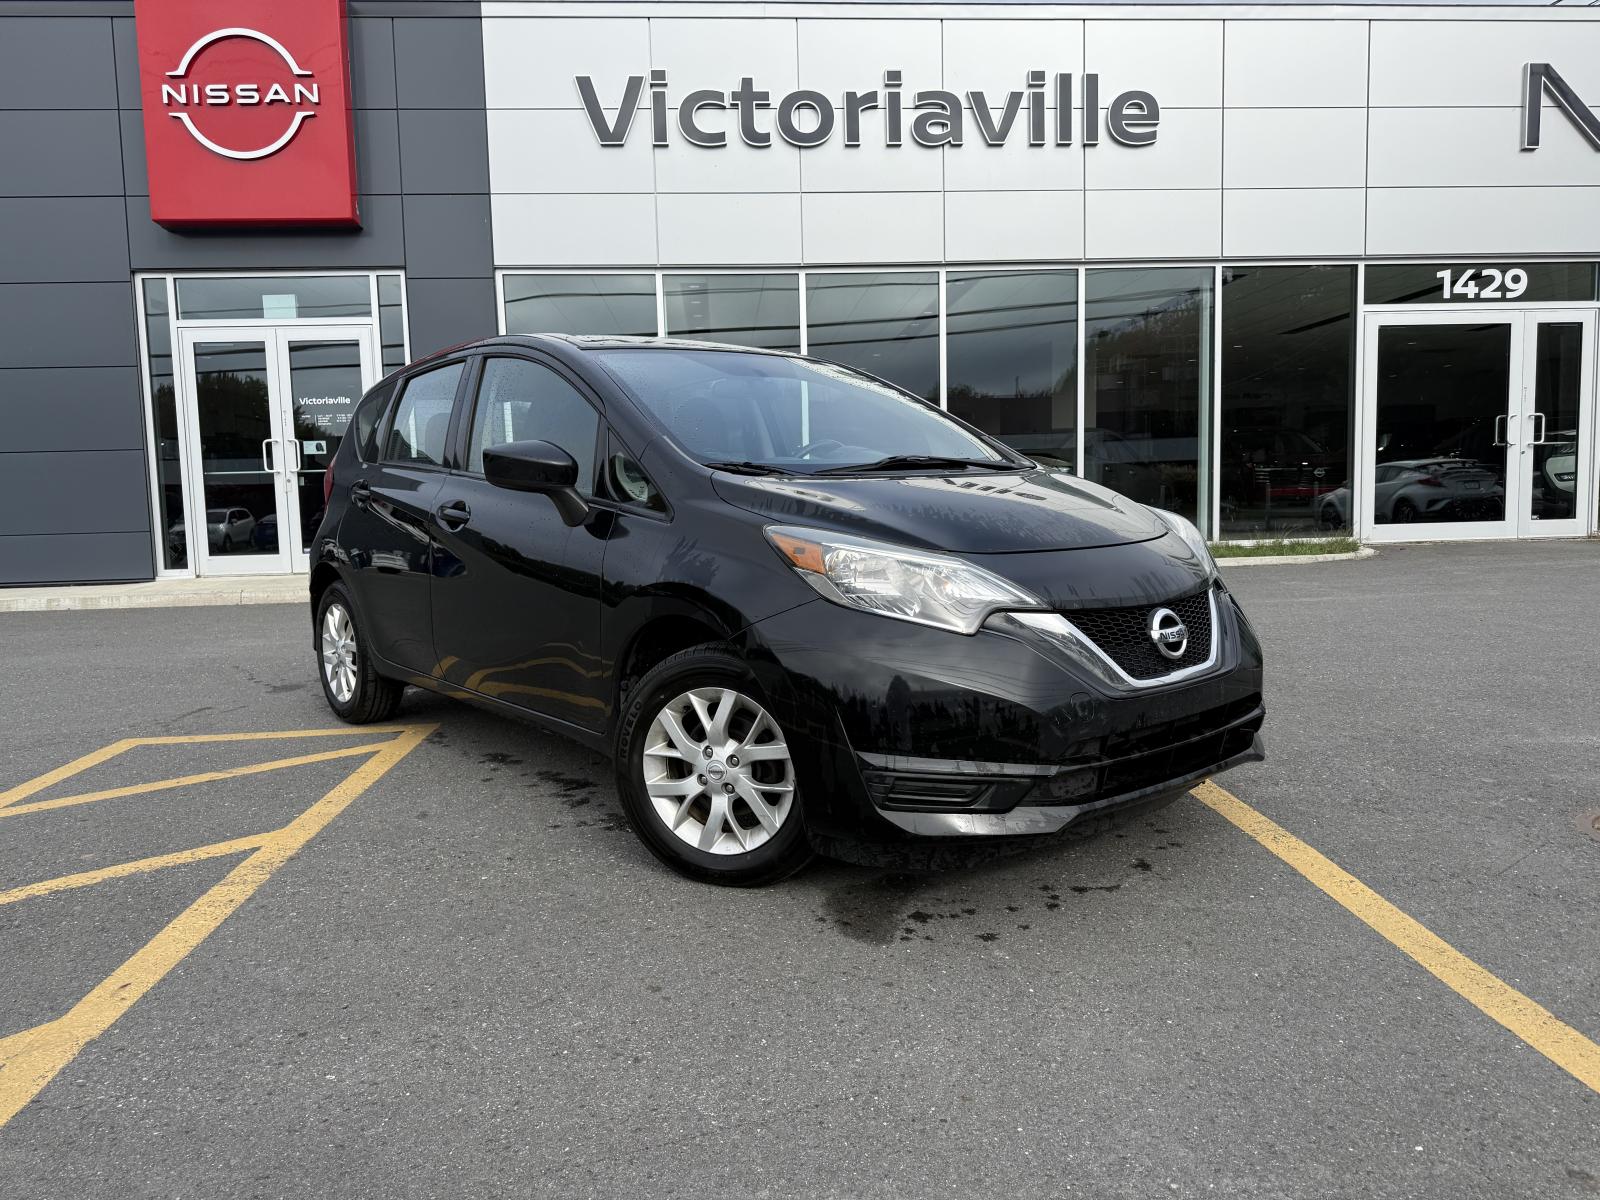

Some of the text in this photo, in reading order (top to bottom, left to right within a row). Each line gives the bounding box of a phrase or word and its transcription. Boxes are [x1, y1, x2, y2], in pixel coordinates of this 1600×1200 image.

[161, 83, 320, 105] NISSAN
[574, 69, 1161, 148] Victoriaville
[1436, 268, 1528, 299] 1429
[299, 397, 351, 405] Victoriaville
[619, 700, 641, 759] ROVELO
